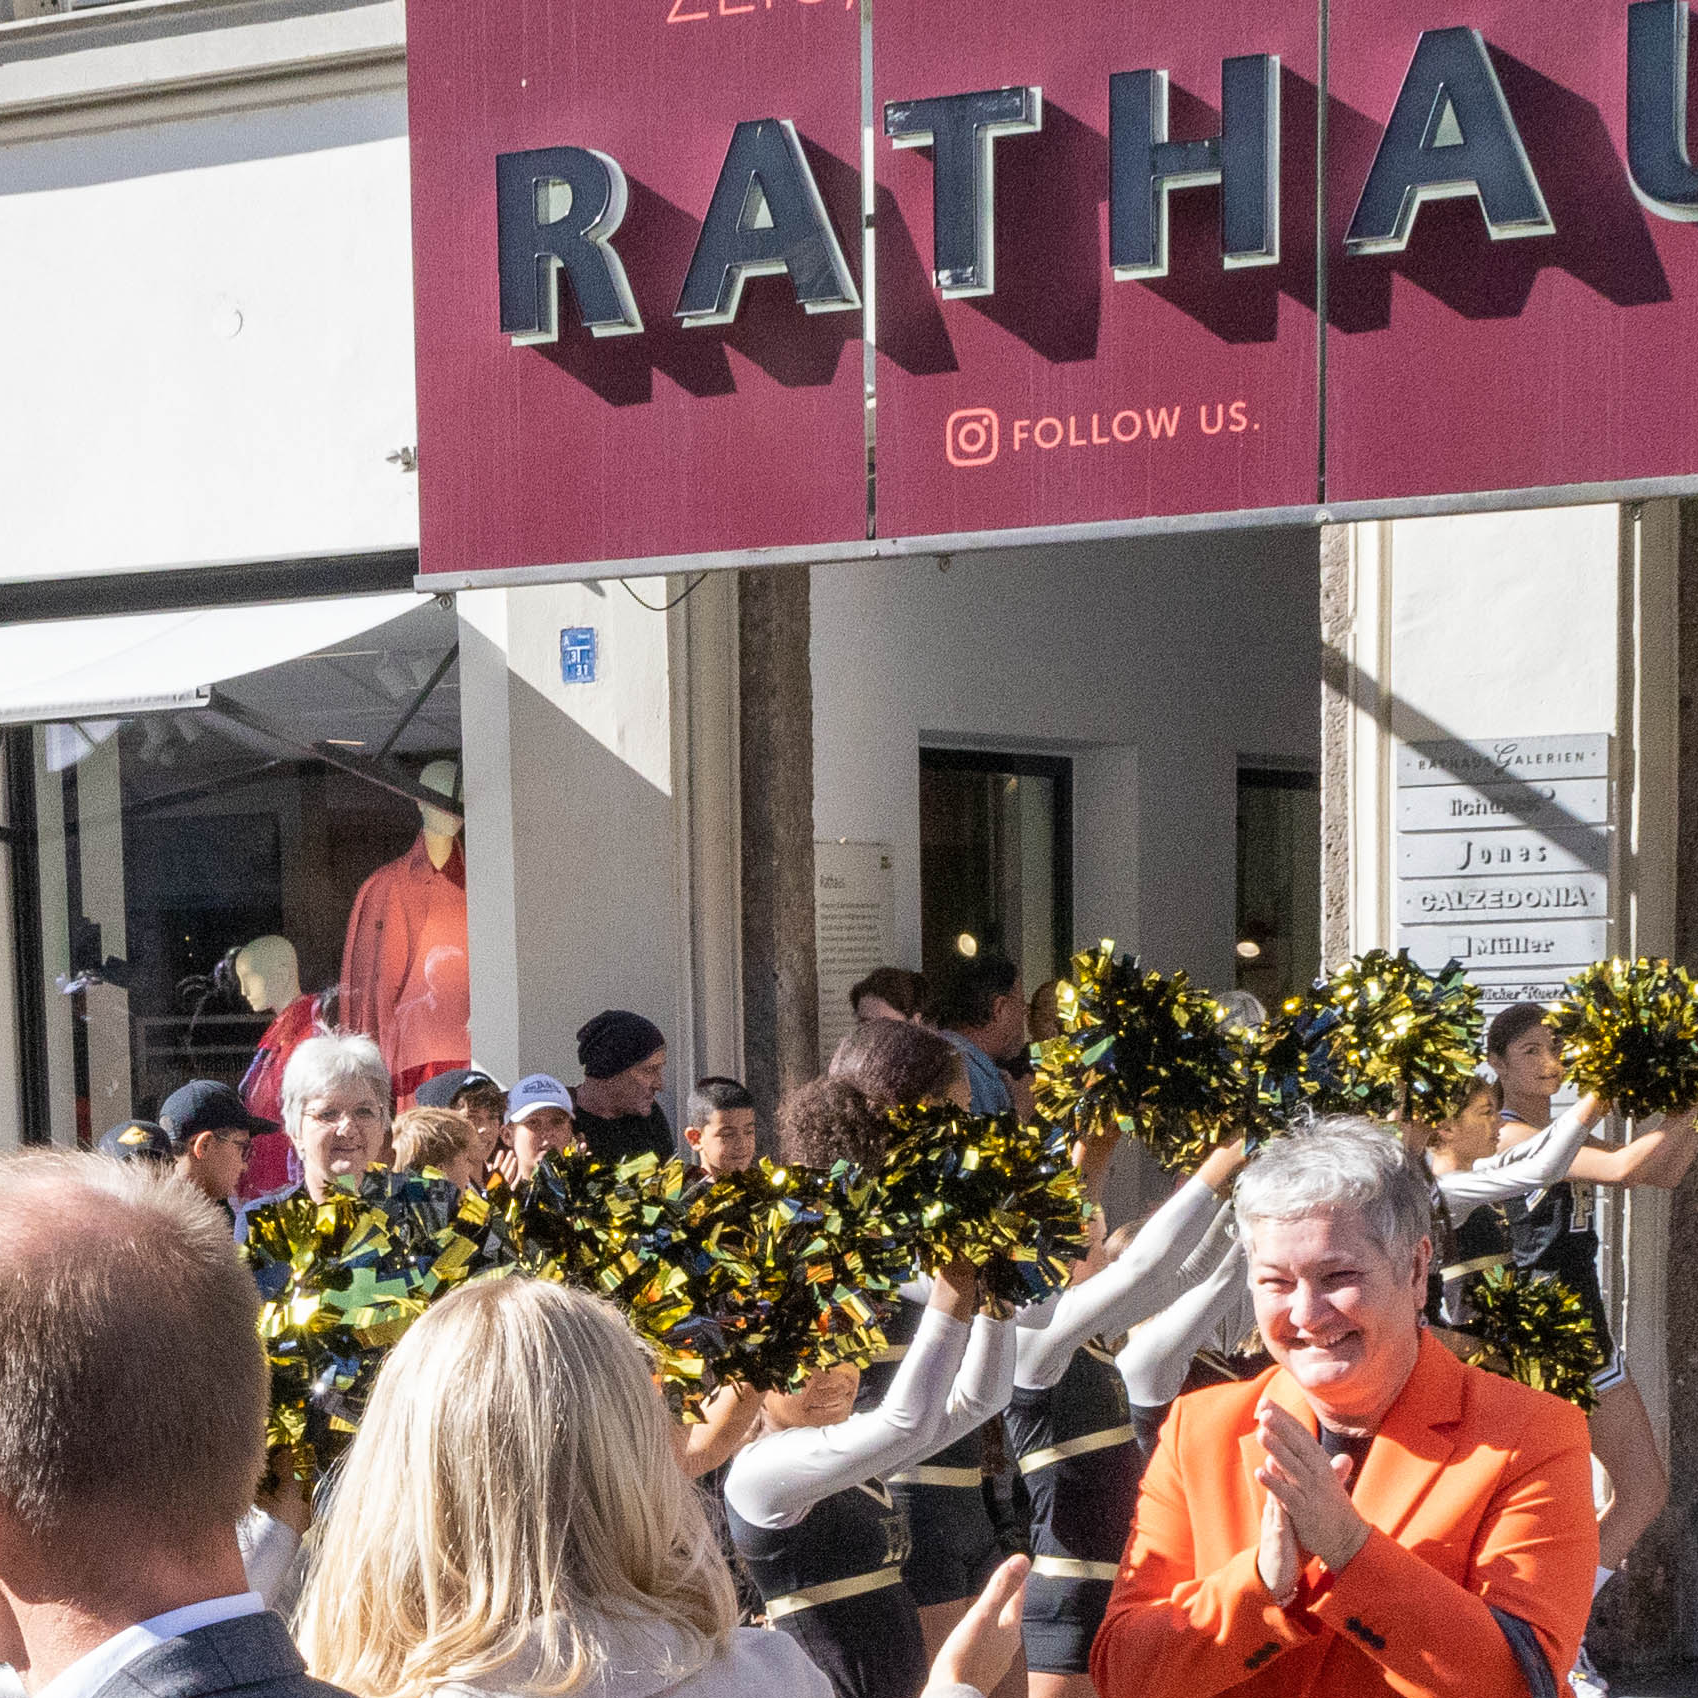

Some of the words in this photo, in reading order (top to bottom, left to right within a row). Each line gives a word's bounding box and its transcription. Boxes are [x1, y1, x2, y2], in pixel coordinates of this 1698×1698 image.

[1013, 405, 1181, 451] FOLLOW
[1200, 401, 1260, 435] US.
[1457, 841, 1547, 870] Jones
[1420, 886, 1589, 912] CALZEDONIA
[1476, 936, 1555, 956] Müller
